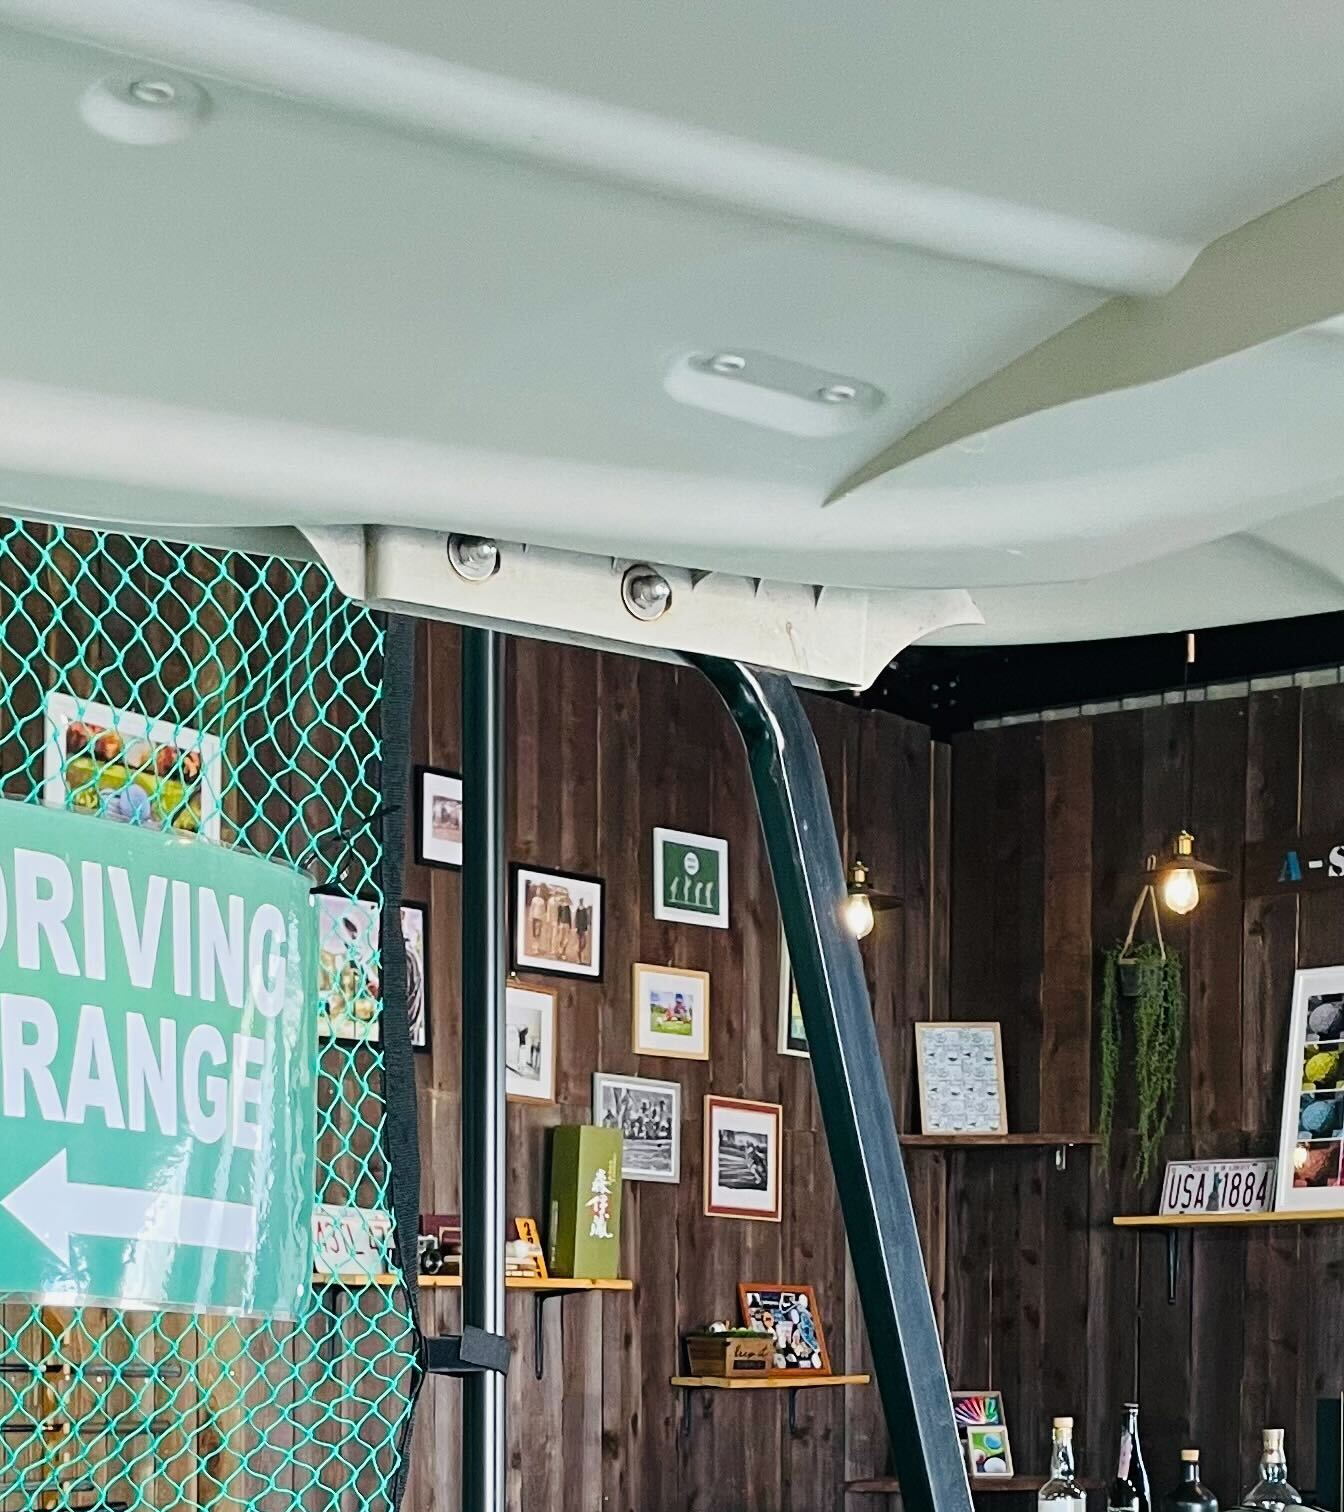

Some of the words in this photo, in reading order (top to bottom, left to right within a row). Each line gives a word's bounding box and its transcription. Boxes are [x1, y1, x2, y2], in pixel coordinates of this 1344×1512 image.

[0, 992, 266, 1151] RANGE
[1168, 1173, 1206, 1209] USA
[1221, 1171, 1269, 1208] 1884
